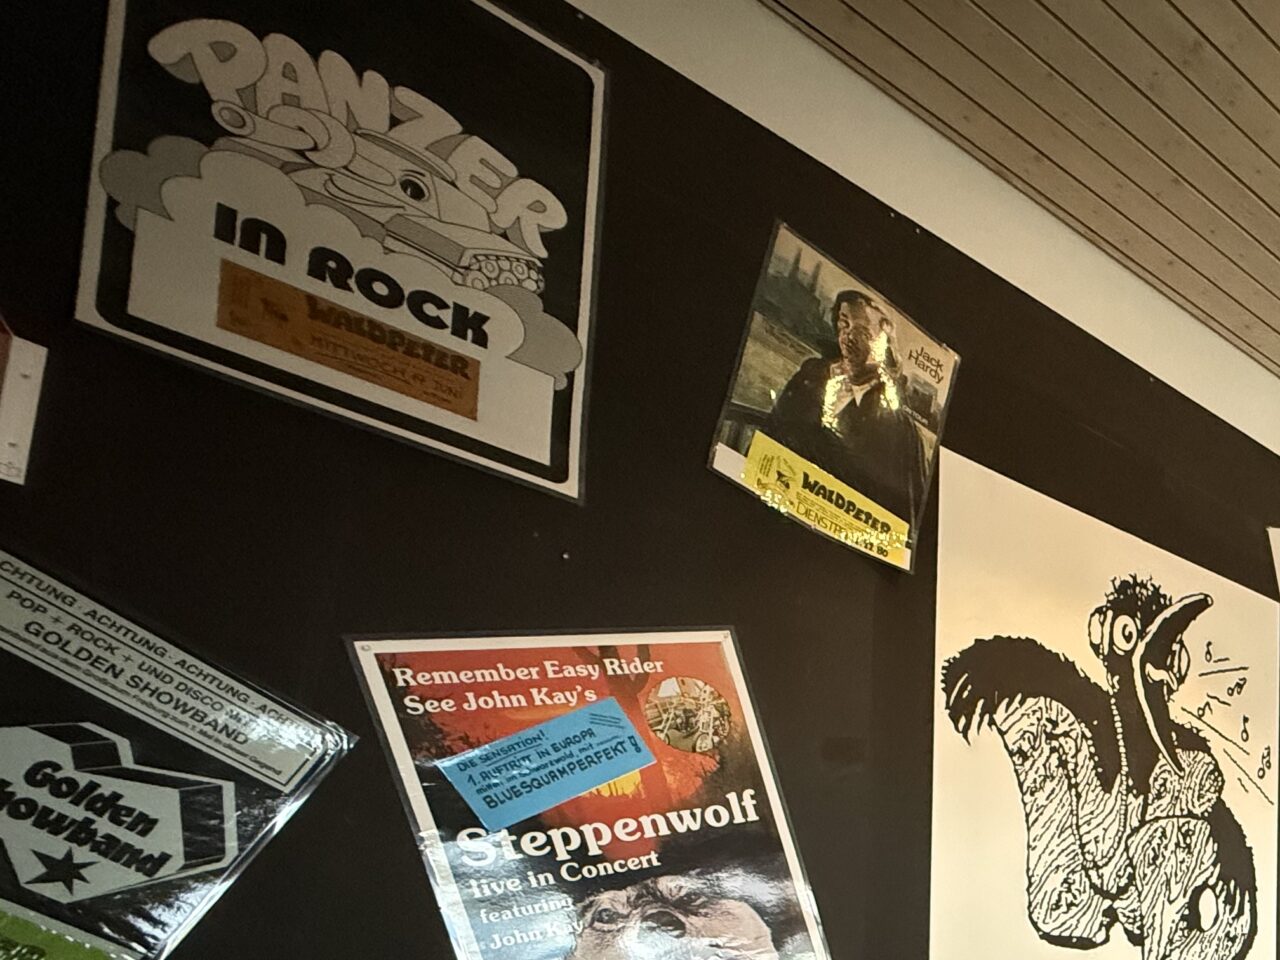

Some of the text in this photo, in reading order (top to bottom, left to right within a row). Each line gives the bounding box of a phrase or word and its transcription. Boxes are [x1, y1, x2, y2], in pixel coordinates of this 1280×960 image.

[148, 18, 568, 258] PANZER
[307, 245, 489, 349] ROCK
[908, 349, 944, 384] Hardy
[916, 346, 944, 373] Jack
[6, 589, 48, 617] POP
[66, 624, 119, 655] ROCK
[138, 661, 173, 686] UND
[176, 682, 224, 711] DISCO
[85, 608, 166, 658] ACHTUNG
[174, 657, 250, 704] ACHTUNG
[24, 621, 250, 746] GOLDEN SHOWBAND
[393, 657, 663, 688] Remember Easy Rider
[403, 686, 597, 716] See John Kay's
[552, 728, 596, 754] EUROPA
[24, 760, 158, 837] Golden
[457, 789, 760, 867] Steppenwolf
[527, 871, 556, 888] in
[560, 850, 661, 883] Concert
[480, 898, 573, 923] featuring
[490, 929, 541, 949] John
